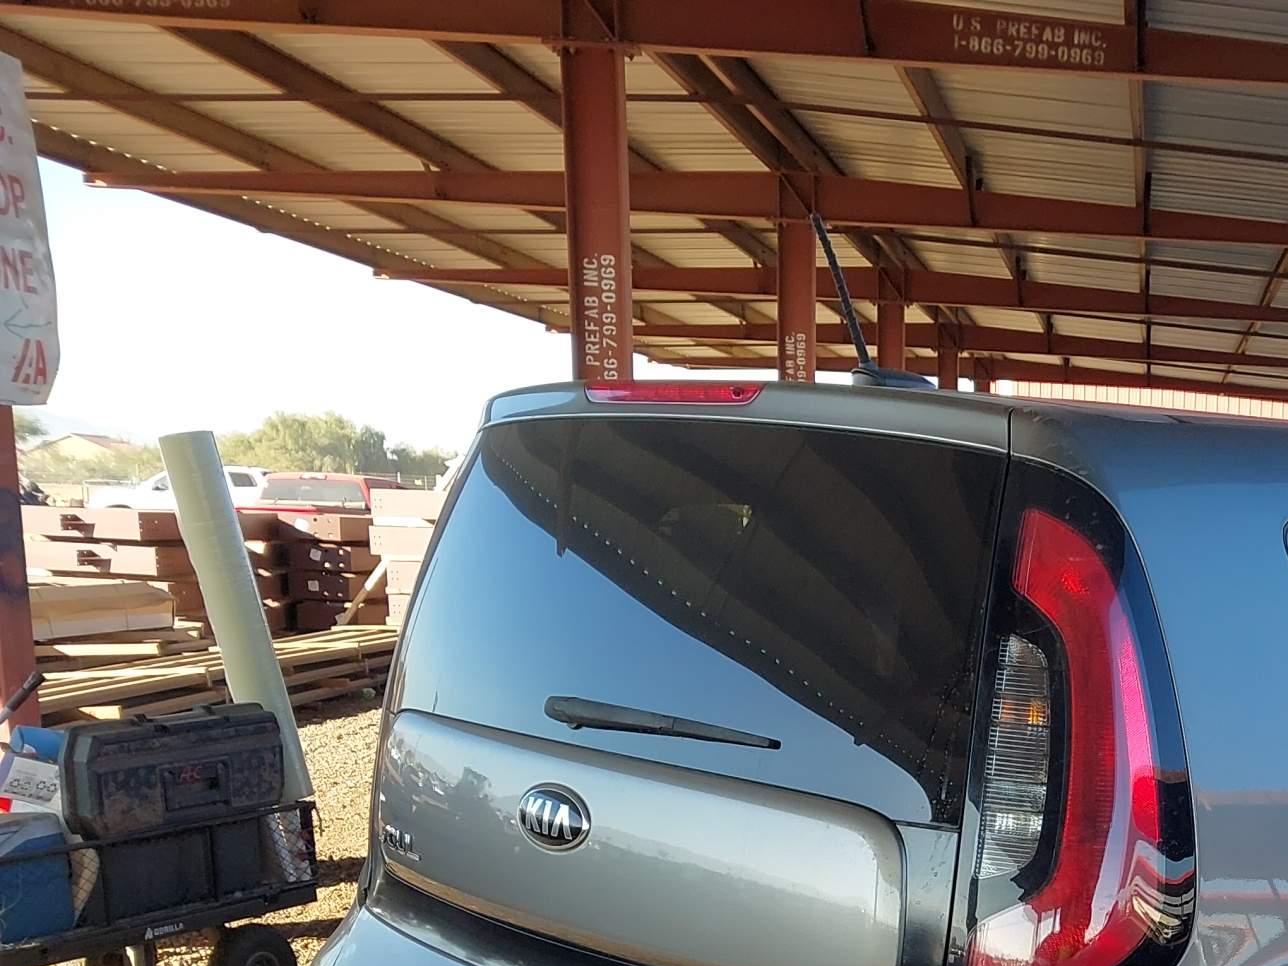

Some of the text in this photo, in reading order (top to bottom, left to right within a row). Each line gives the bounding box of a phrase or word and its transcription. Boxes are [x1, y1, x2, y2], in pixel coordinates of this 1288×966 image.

[953, 34, 1105, 65] 1-866-799-0969
[996, 17, 1066, 43] PREFAB
[1073, 28, 1107, 49] INC.
[583, 252, 601, 366] PREFAB INC.
[525, 796, 573, 840] KIA
